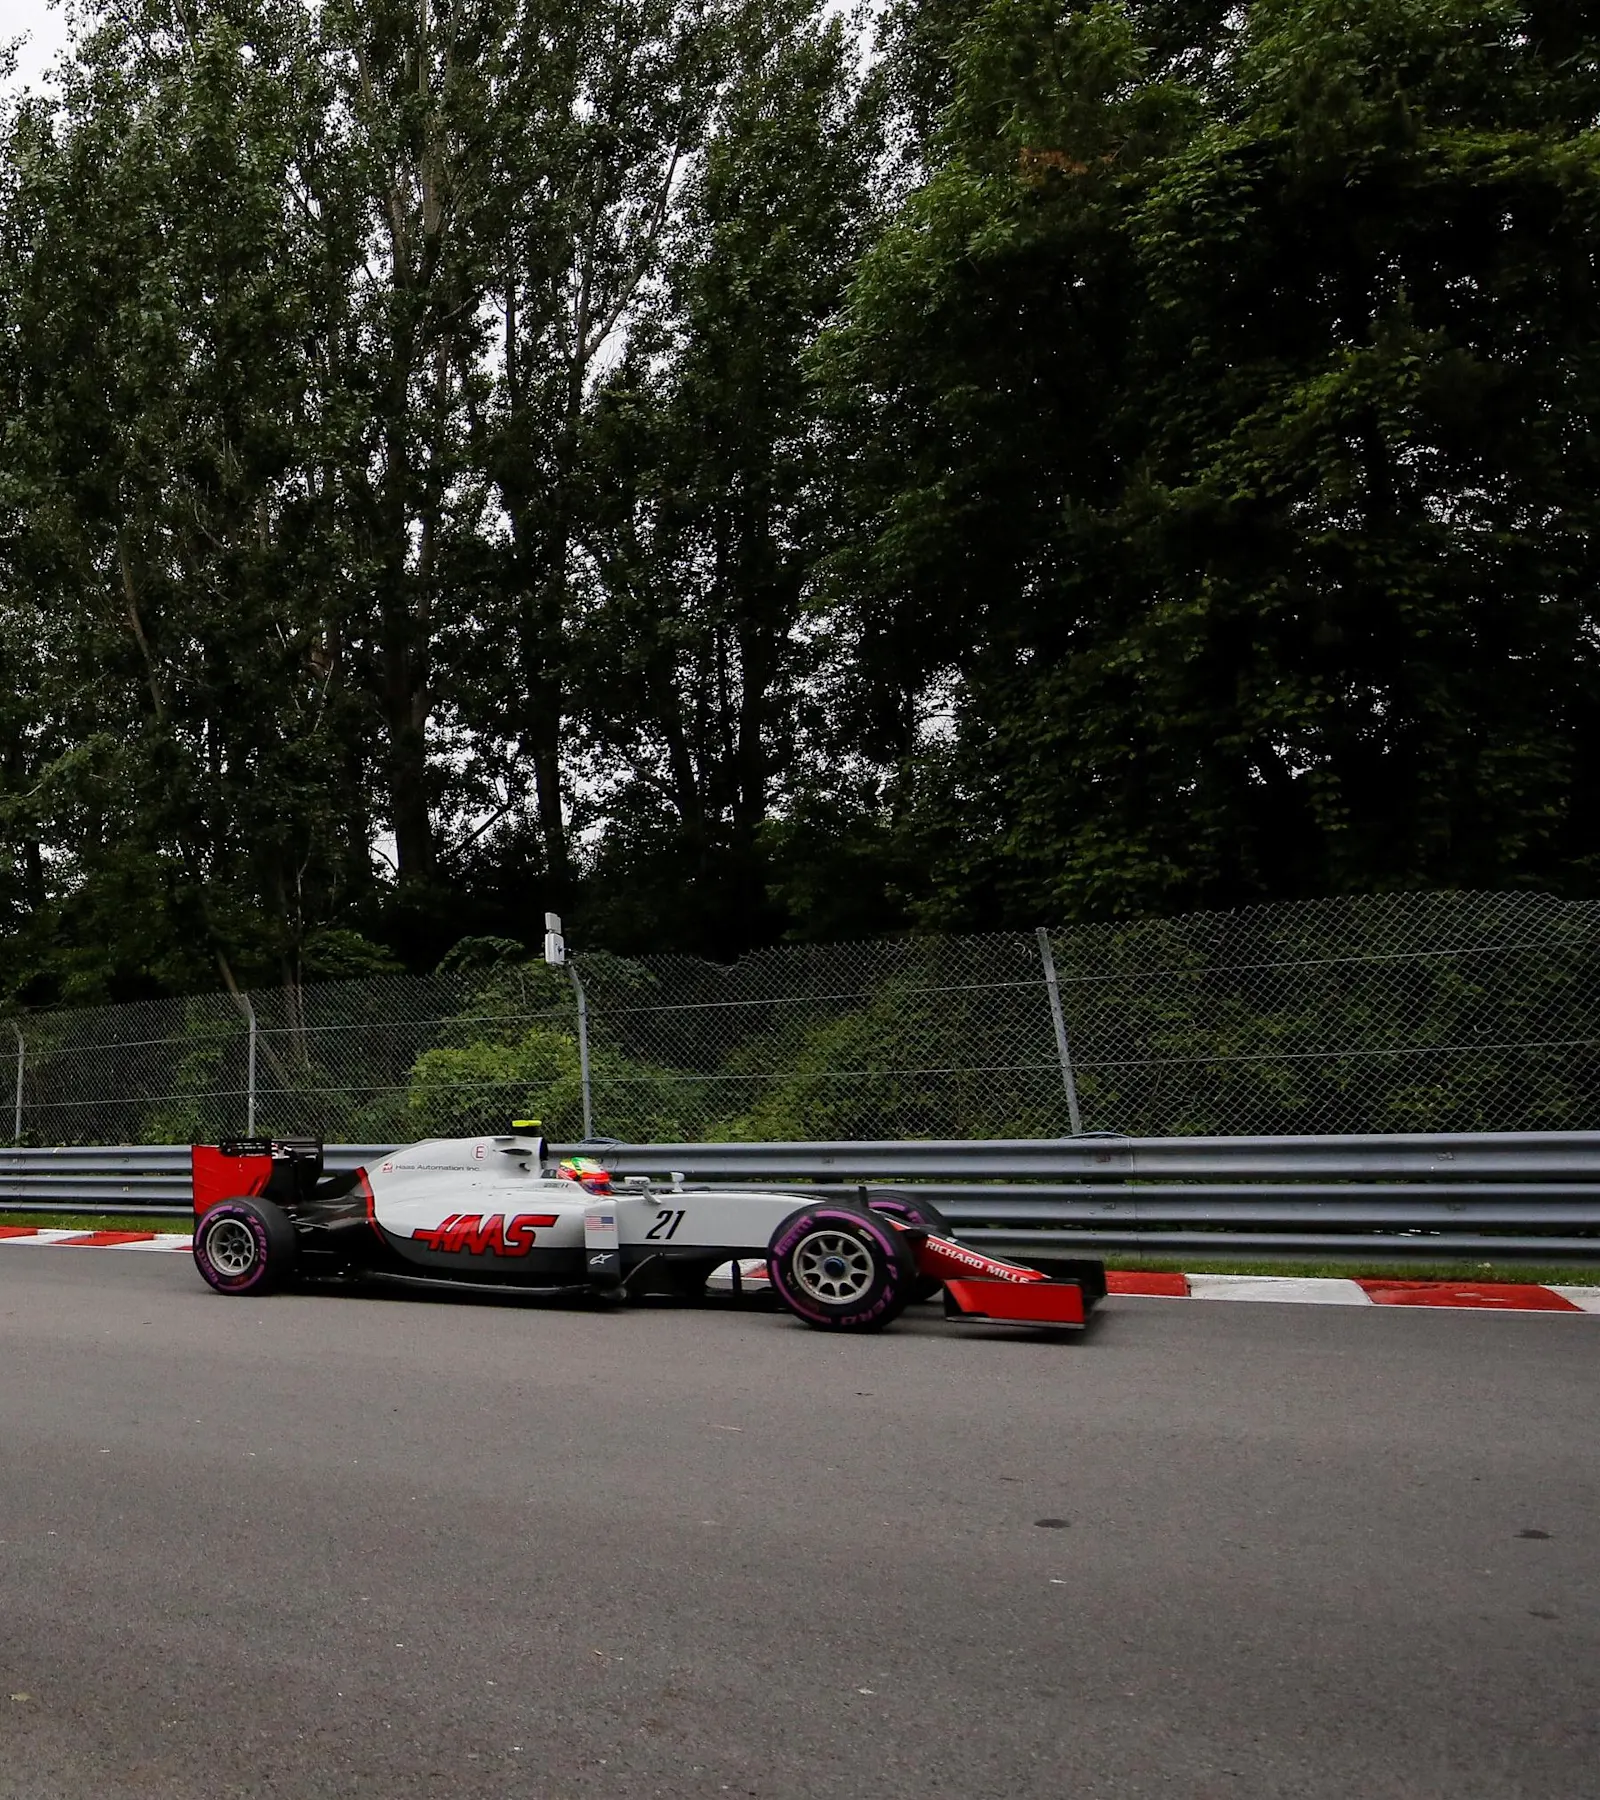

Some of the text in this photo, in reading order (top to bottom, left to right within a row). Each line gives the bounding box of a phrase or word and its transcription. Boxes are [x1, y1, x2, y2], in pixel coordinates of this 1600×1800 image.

[475, 1145, 485, 1159] E
[411, 1213, 560, 1257] HAAS
[645, 1209, 687, 1240] 21
[925, 1240, 985, 1270] RICHARD
